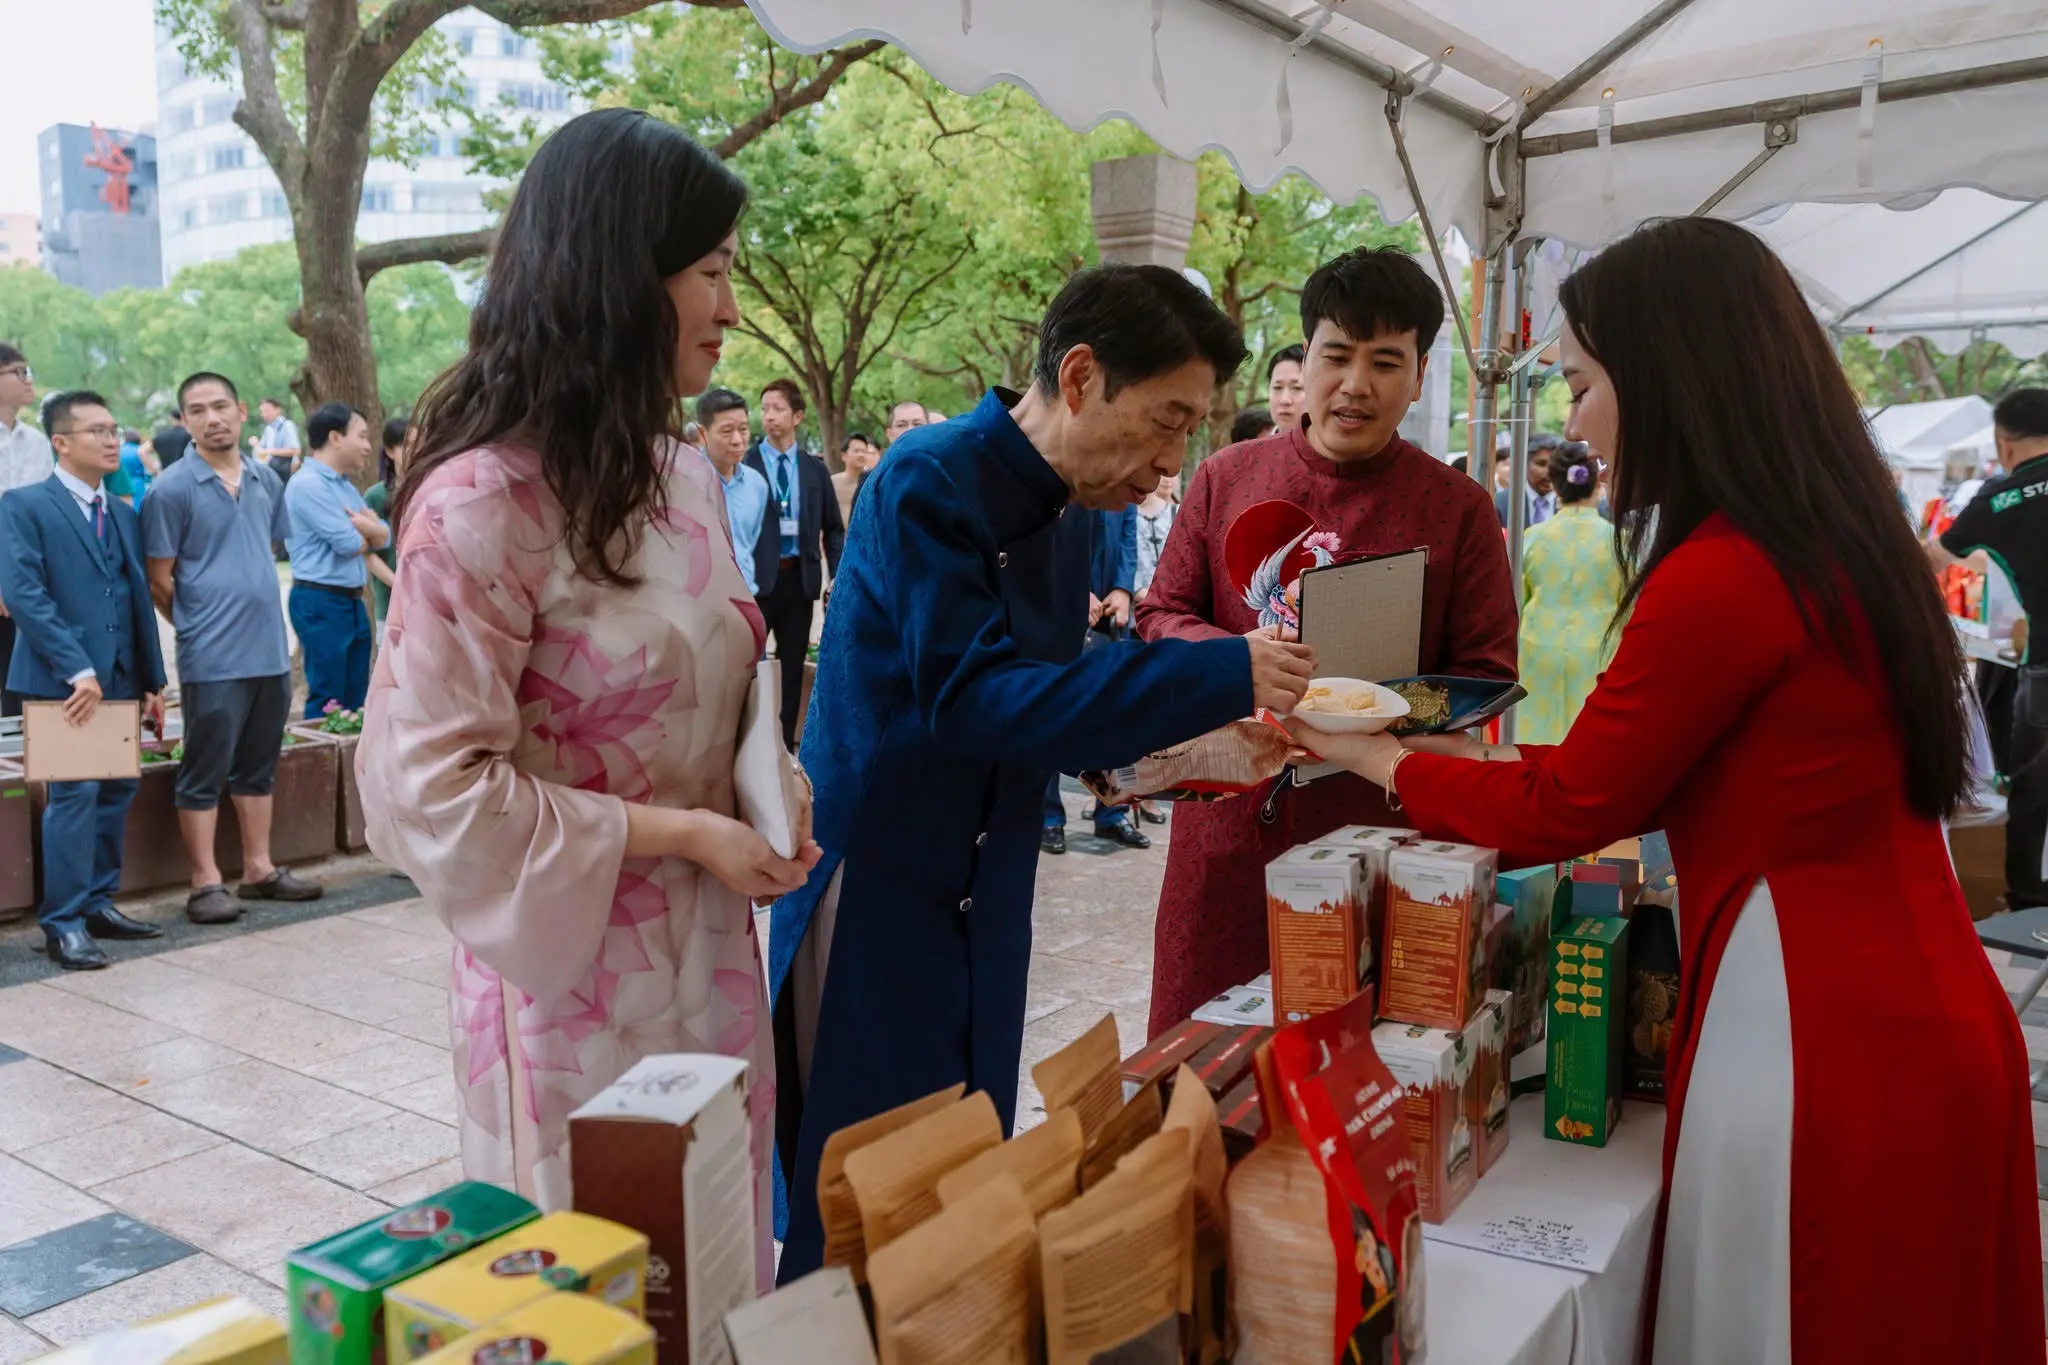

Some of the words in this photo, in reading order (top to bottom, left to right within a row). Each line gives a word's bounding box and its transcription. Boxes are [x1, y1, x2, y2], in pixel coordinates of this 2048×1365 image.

[1393, 939, 1402, 949] 01
[1392, 949, 1404, 958] 02
[1391, 959, 1405, 969] 03
